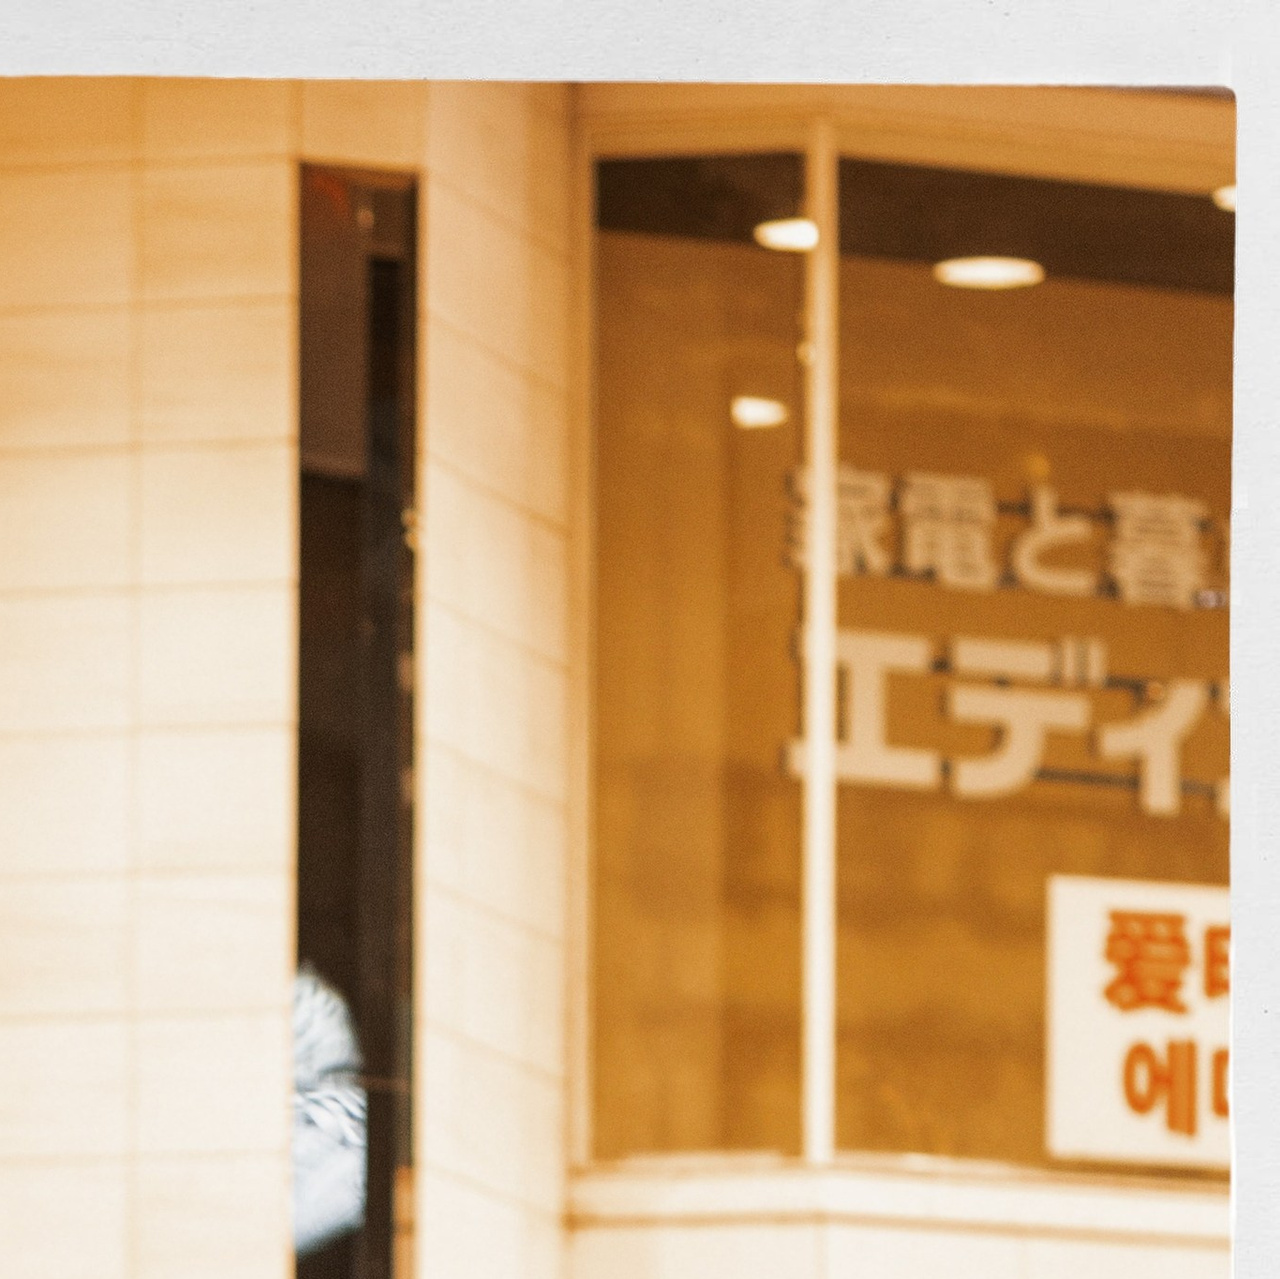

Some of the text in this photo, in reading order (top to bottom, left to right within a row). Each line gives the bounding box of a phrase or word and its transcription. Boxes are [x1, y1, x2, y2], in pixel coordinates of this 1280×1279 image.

[788, 627, 1229, 817] エディ
[1124, 1039, 1230, 1139] 에
